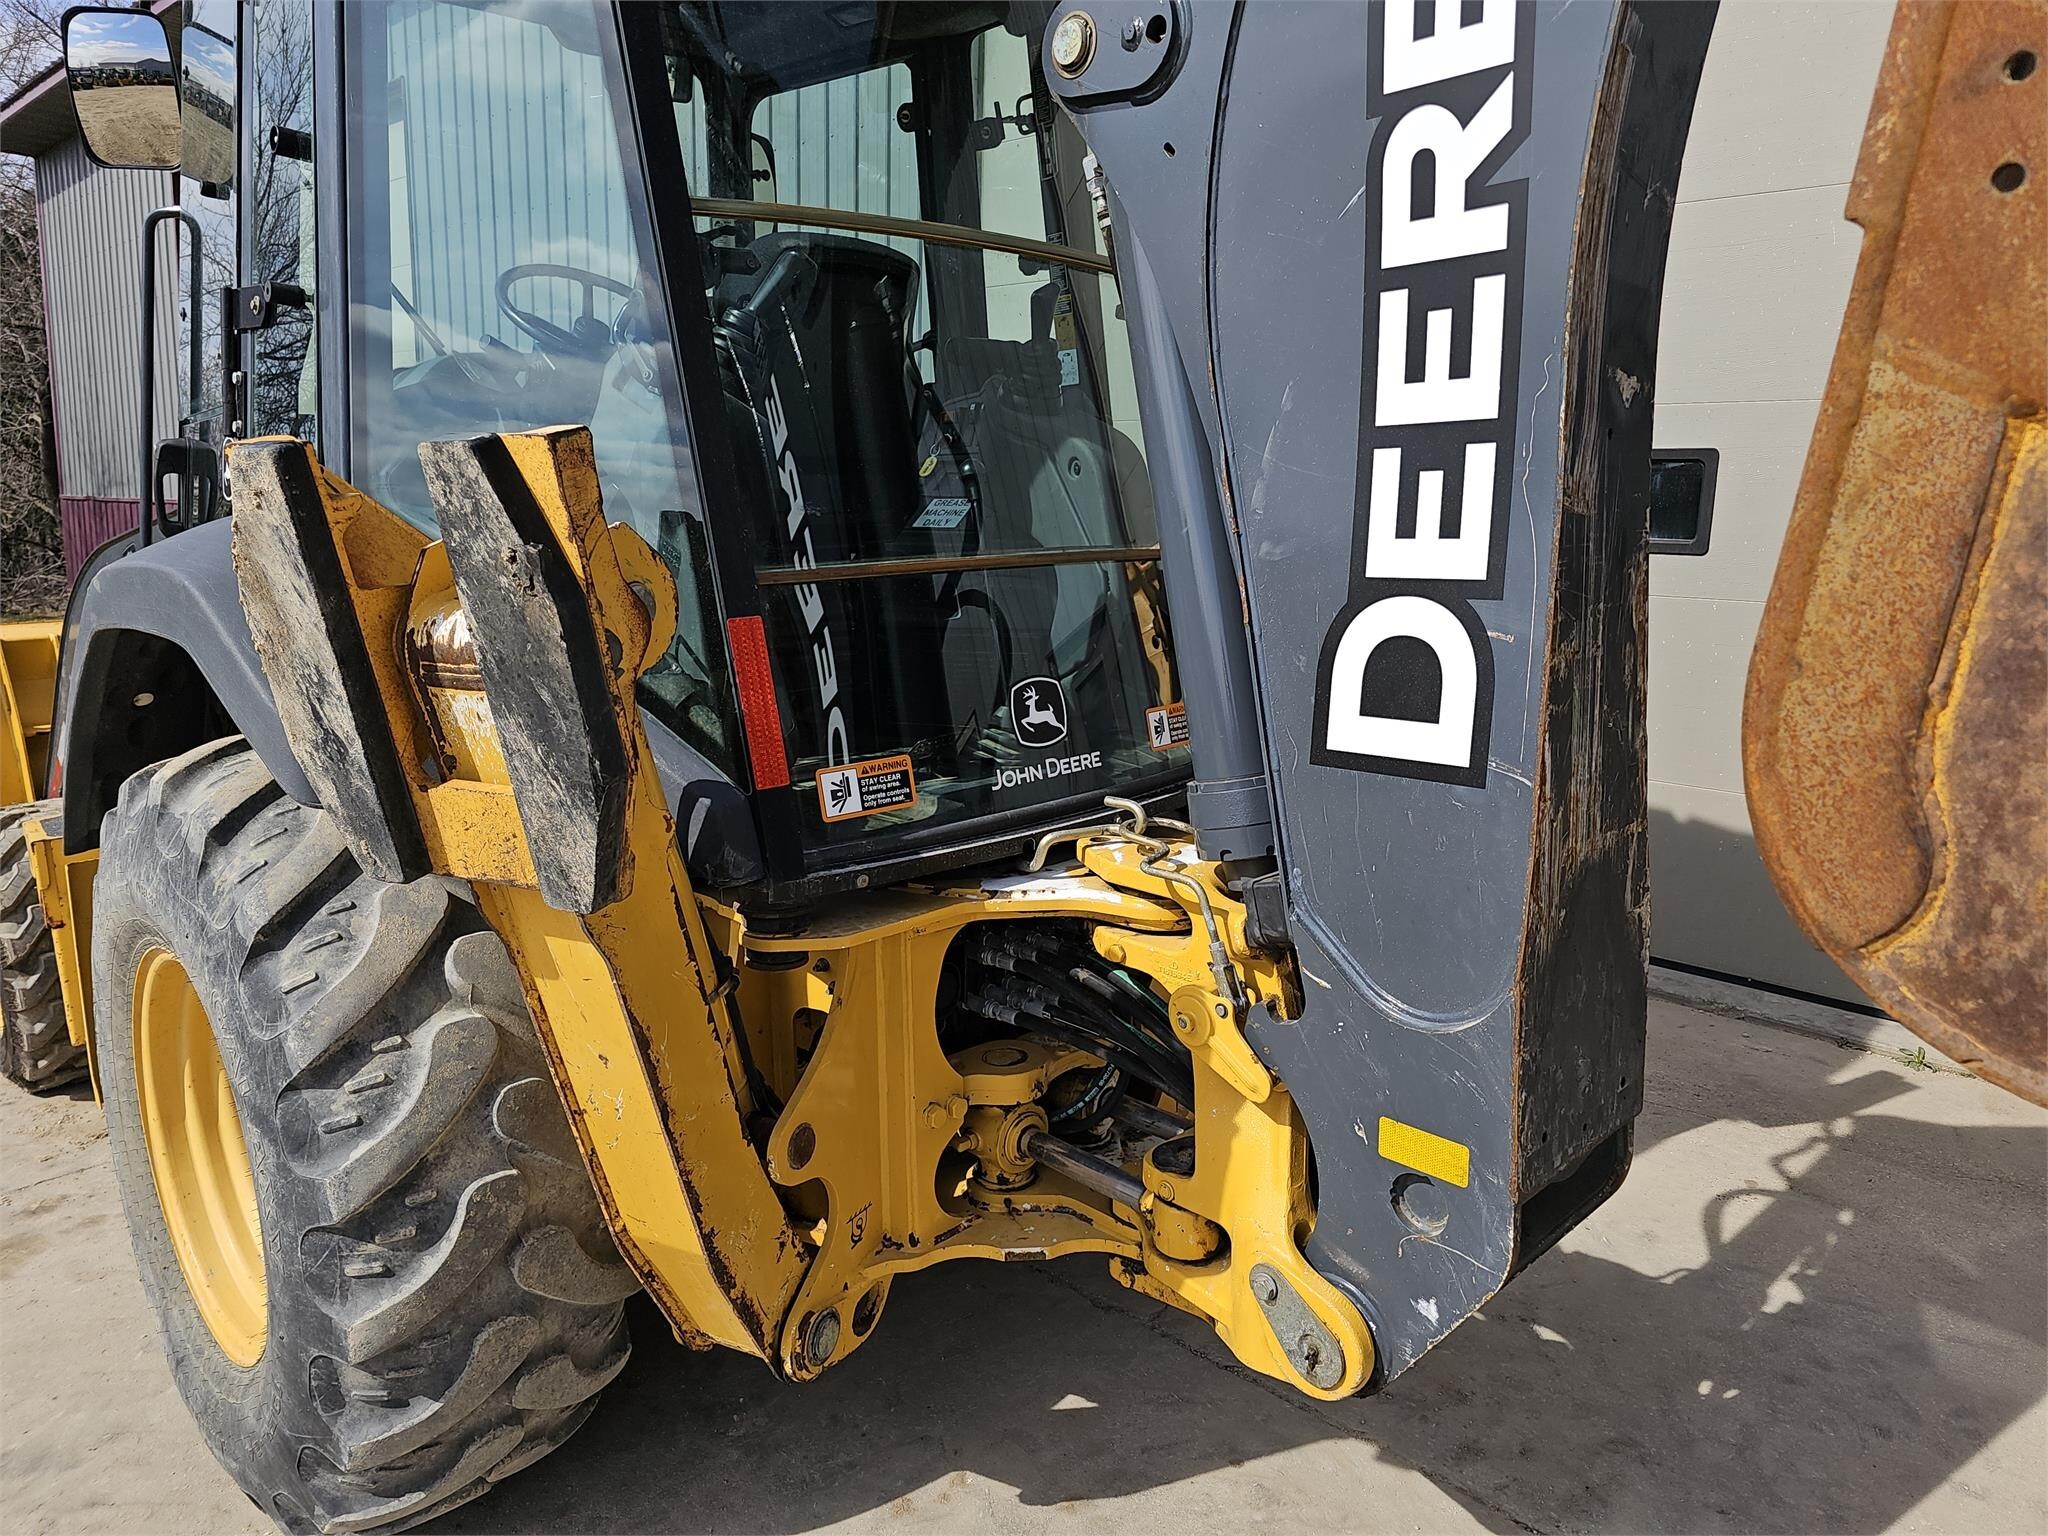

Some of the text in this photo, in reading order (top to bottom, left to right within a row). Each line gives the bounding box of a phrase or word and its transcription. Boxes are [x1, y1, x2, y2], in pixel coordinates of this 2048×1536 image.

[1326, 0, 1516, 768] DEERE
[934, 499, 970, 507] GREASE
[923, 508, 967, 516] MACHINE
[922, 518, 952, 526] DAILY
[868, 759, 908, 773] WARNING
[991, 751, 1103, 791] JOHN DEERE
[860, 773, 901, 786] STAY CLEAR
[863, 788, 910, 801] Operate controls
